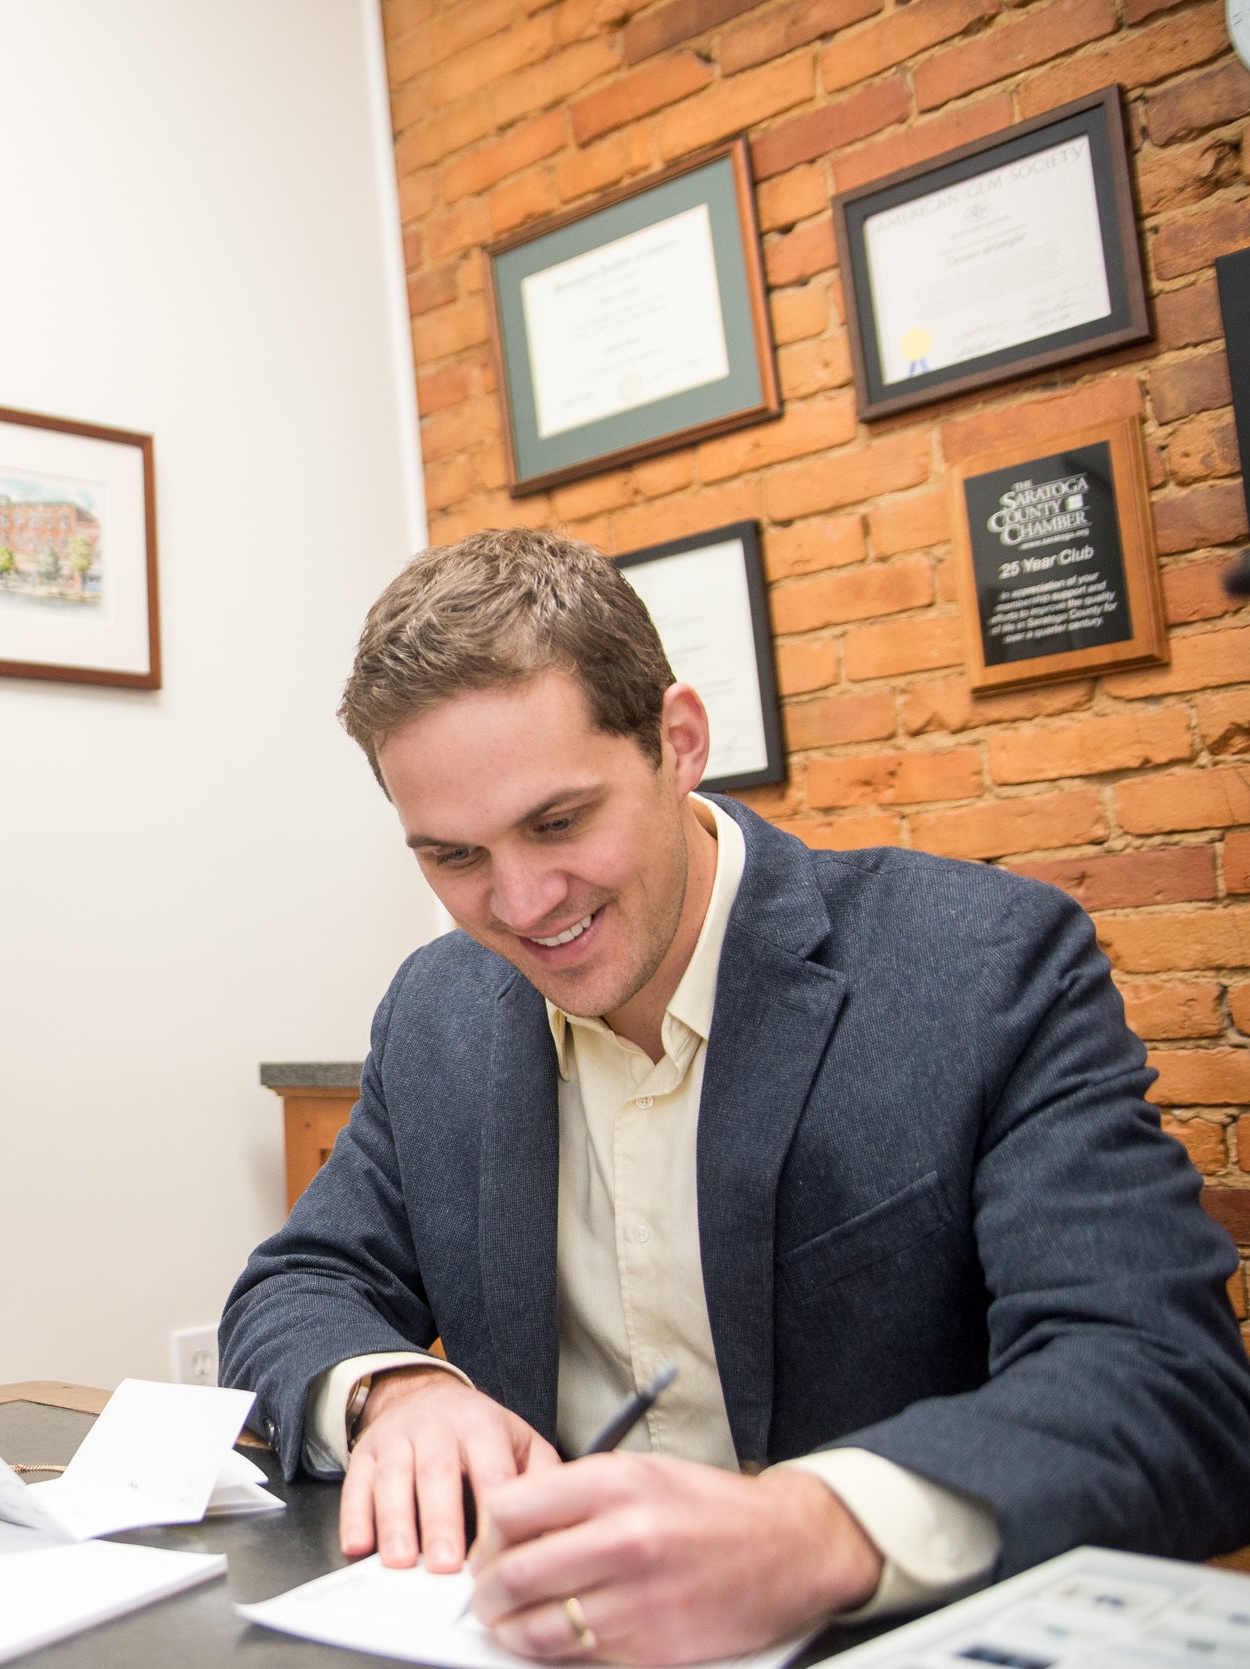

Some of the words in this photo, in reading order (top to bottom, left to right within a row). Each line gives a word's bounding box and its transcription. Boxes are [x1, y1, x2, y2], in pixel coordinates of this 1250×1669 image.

[876, 194, 959, 233] AMERICAN
[965, 175, 1004, 199] GEM
[1009, 142, 1085, 182] SOCIETY
[999, 475, 1089, 511] SARATOGA
[1012, 479, 1033, 491] THE
[987, 498, 1064, 533] COUNTY
[1000, 510, 1088, 546] CHAMBER
[998, 561, 1021, 580] 25
[1021, 554, 1057, 574] Year
[1057, 544, 1094, 566] Club
[1077, 571, 1101, 586] your
[1087, 580, 1107, 592] and
[1067, 598, 1083, 609] the
[1068, 605, 1103, 621] County
